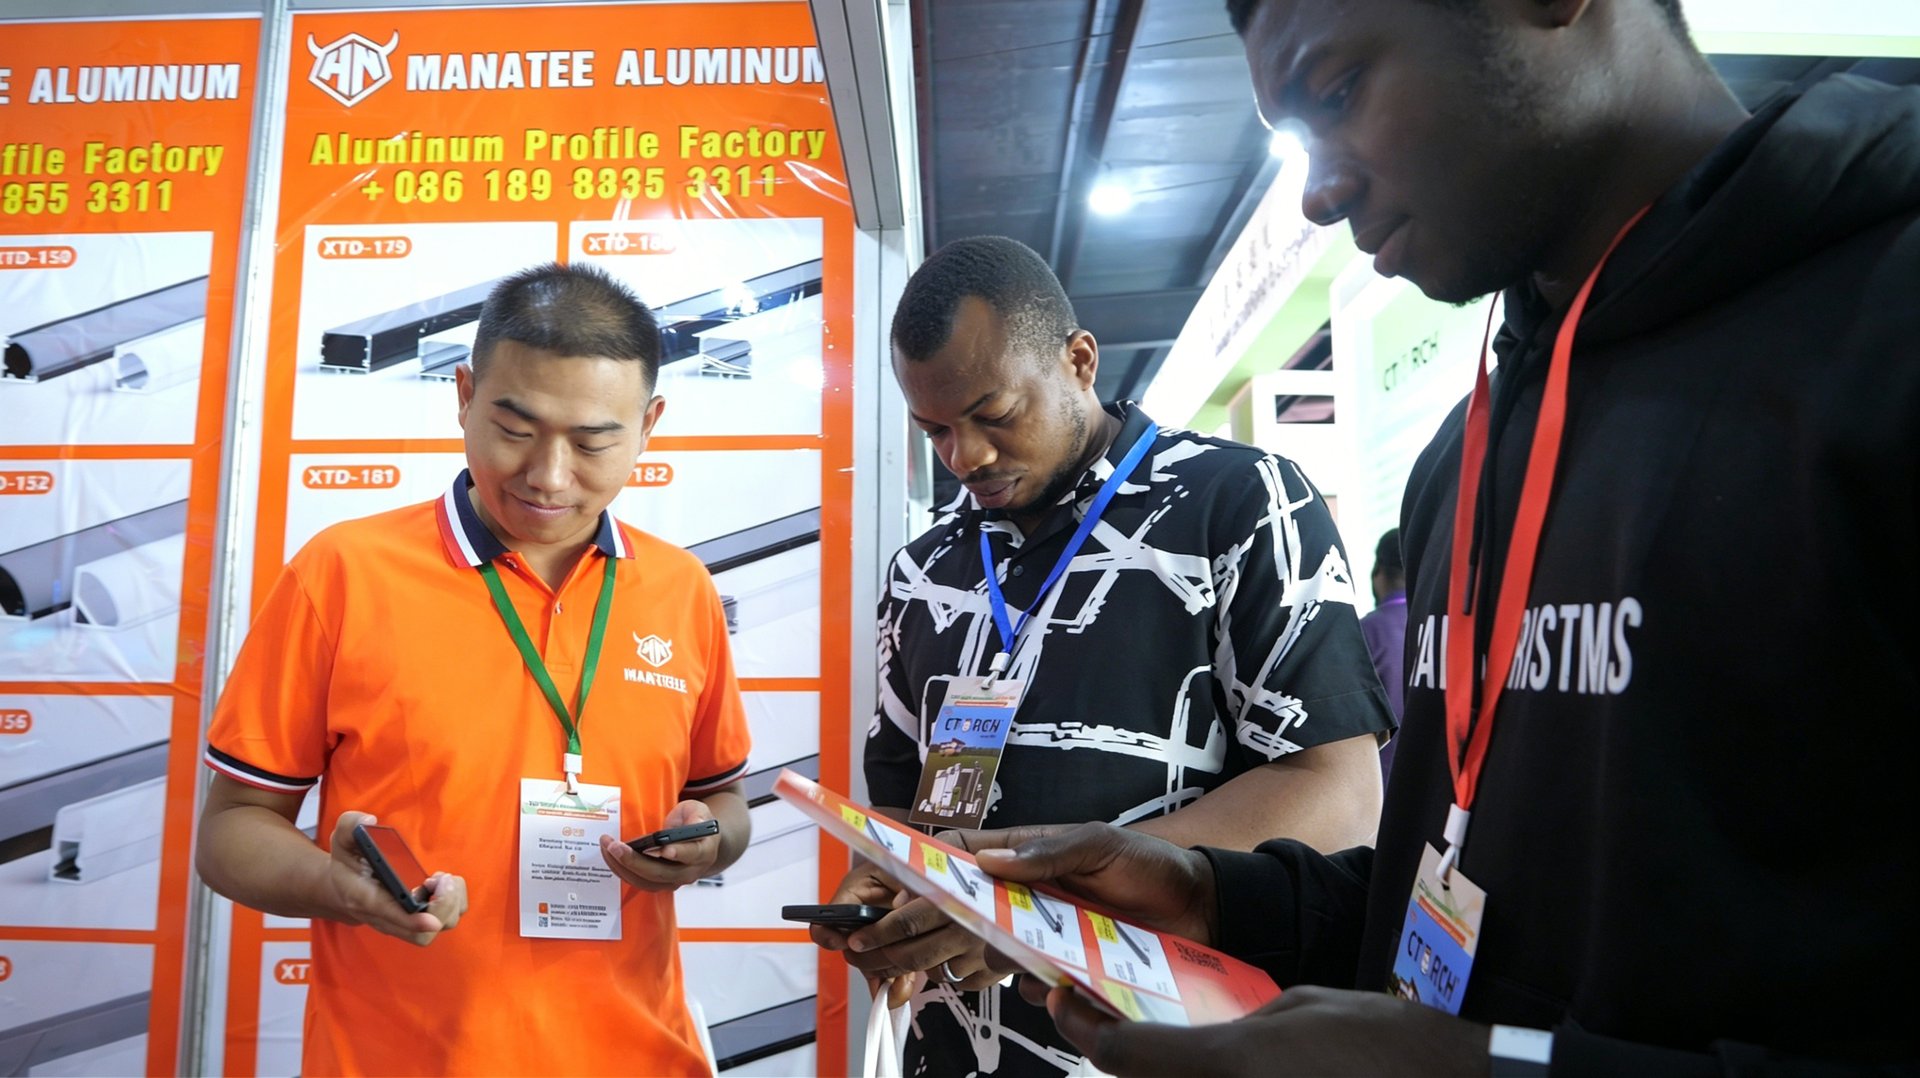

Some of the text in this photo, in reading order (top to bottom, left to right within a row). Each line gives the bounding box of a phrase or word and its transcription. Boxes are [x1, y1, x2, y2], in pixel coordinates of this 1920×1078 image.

[28, 63, 241, 104] ALUMINUM
[405, 50, 593, 91] MANATEE
[83, 141, 225, 176] Factory
[310, 125, 826, 165] Aluminum Profile Factory
[85, 179, 173, 214] 3311
[484, 168, 552, 202] 189
[686, 164, 776, 198] 3311
[0, 250, 73, 266] TD-150
[323, 238, 408, 256] XTD-179
[1383, 331, 1438, 391] CTRCH
[308, 468, 394, 486] XTD-181
[1506, 596, 1643, 695] RISTMS
[0, 714, 28, 730] 56
